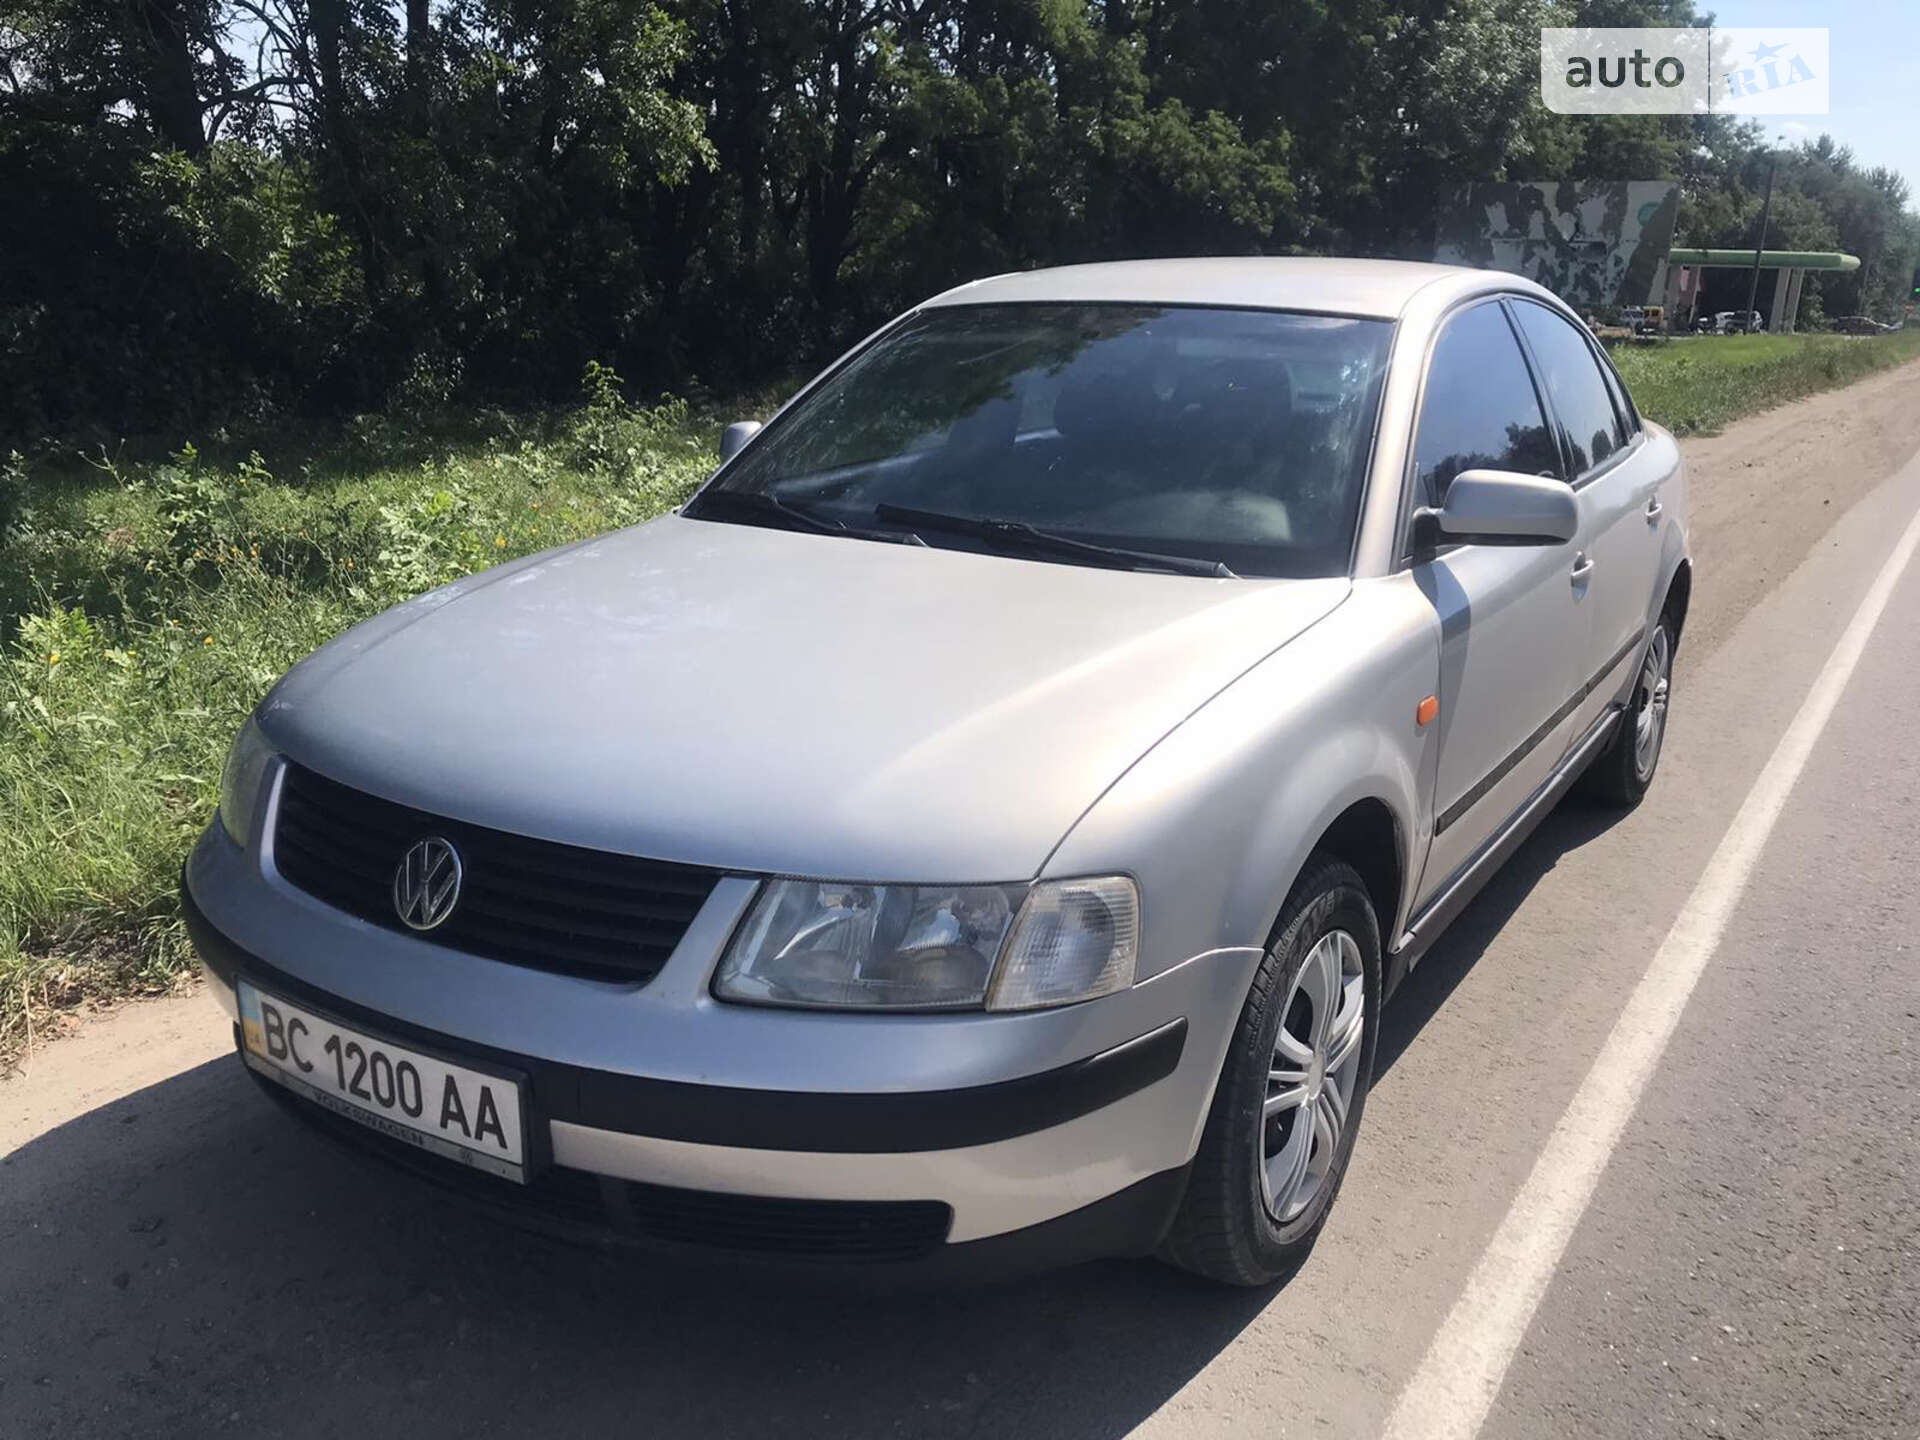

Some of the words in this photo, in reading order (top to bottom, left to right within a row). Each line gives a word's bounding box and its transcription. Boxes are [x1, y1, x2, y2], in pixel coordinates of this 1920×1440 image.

[261, 1002, 313, 1073] BC
[324, 1034, 423, 1118] 1200
[439, 1074, 508, 1149] AA
